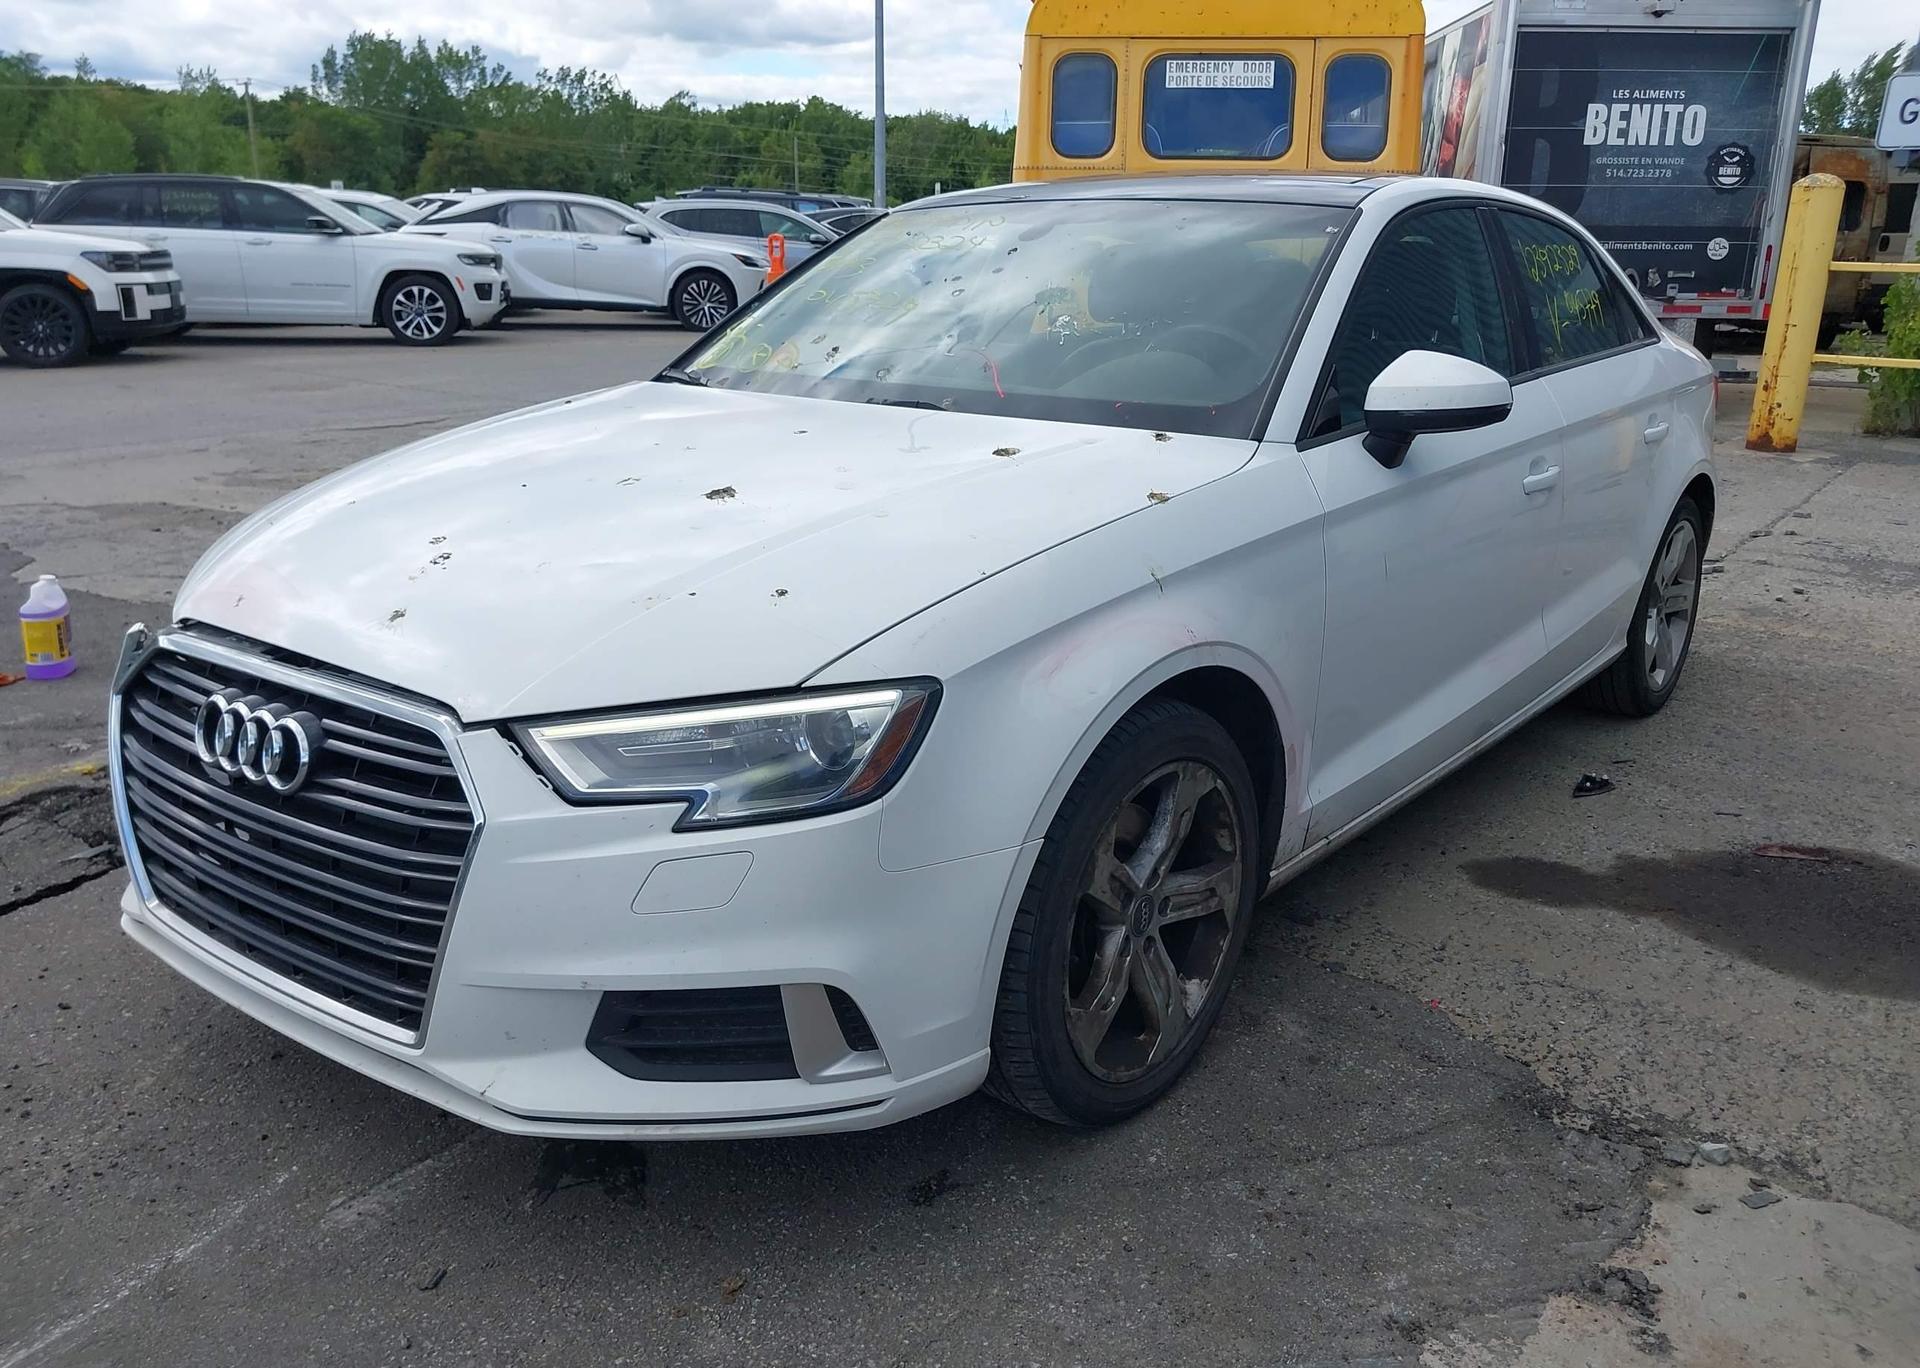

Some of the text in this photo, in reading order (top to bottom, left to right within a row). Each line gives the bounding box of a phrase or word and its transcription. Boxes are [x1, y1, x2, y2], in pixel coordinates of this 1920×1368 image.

[1168, 61, 1272, 73] EMERGENCY DOOR
[1167, 75, 1271, 87] PORTE DE SECOURS
[1612, 89, 1686, 99] LES ALIMENTS
[1583, 103, 1707, 147] BENITO
[1596, 157, 1685, 165] GROSSISTE EN VIANDE
[1605, 168, 1672, 178] 514.723.2378
[1718, 166, 1741, 176] BENITO
